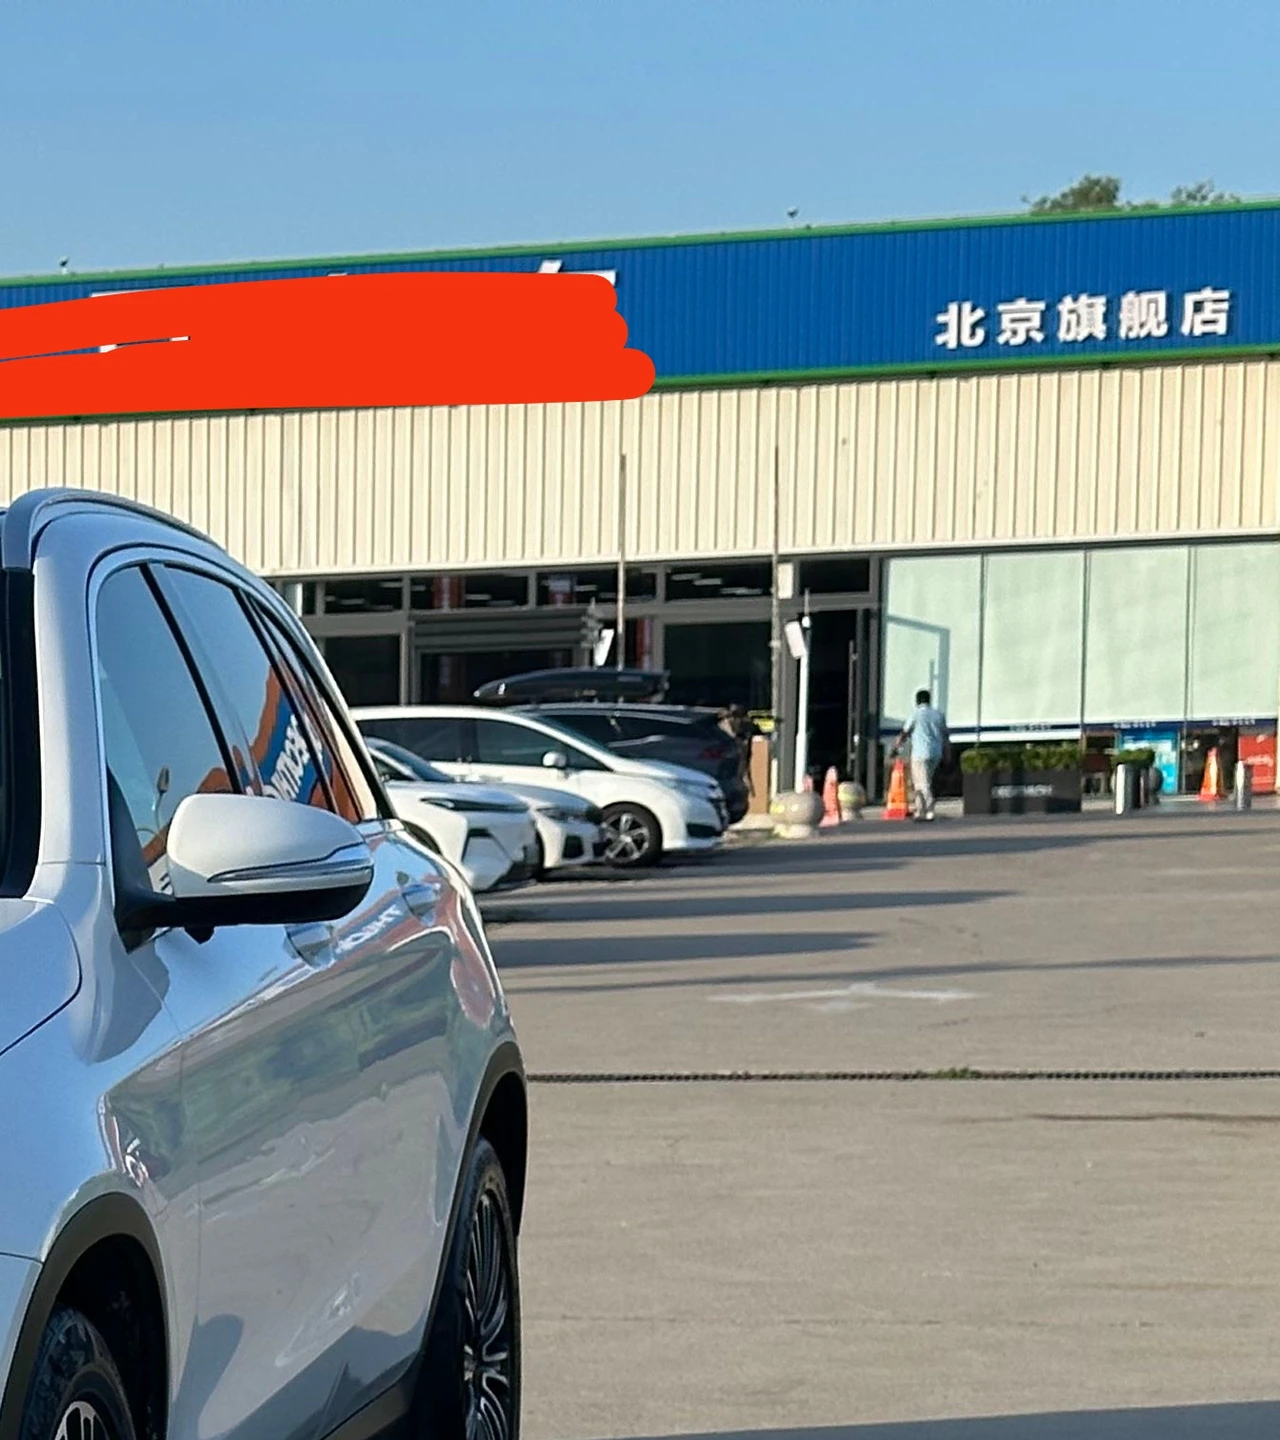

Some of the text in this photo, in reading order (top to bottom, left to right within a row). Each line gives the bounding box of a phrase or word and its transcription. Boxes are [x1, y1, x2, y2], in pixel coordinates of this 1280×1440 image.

[935, 286, 1230, 350] 北京旗舰店
